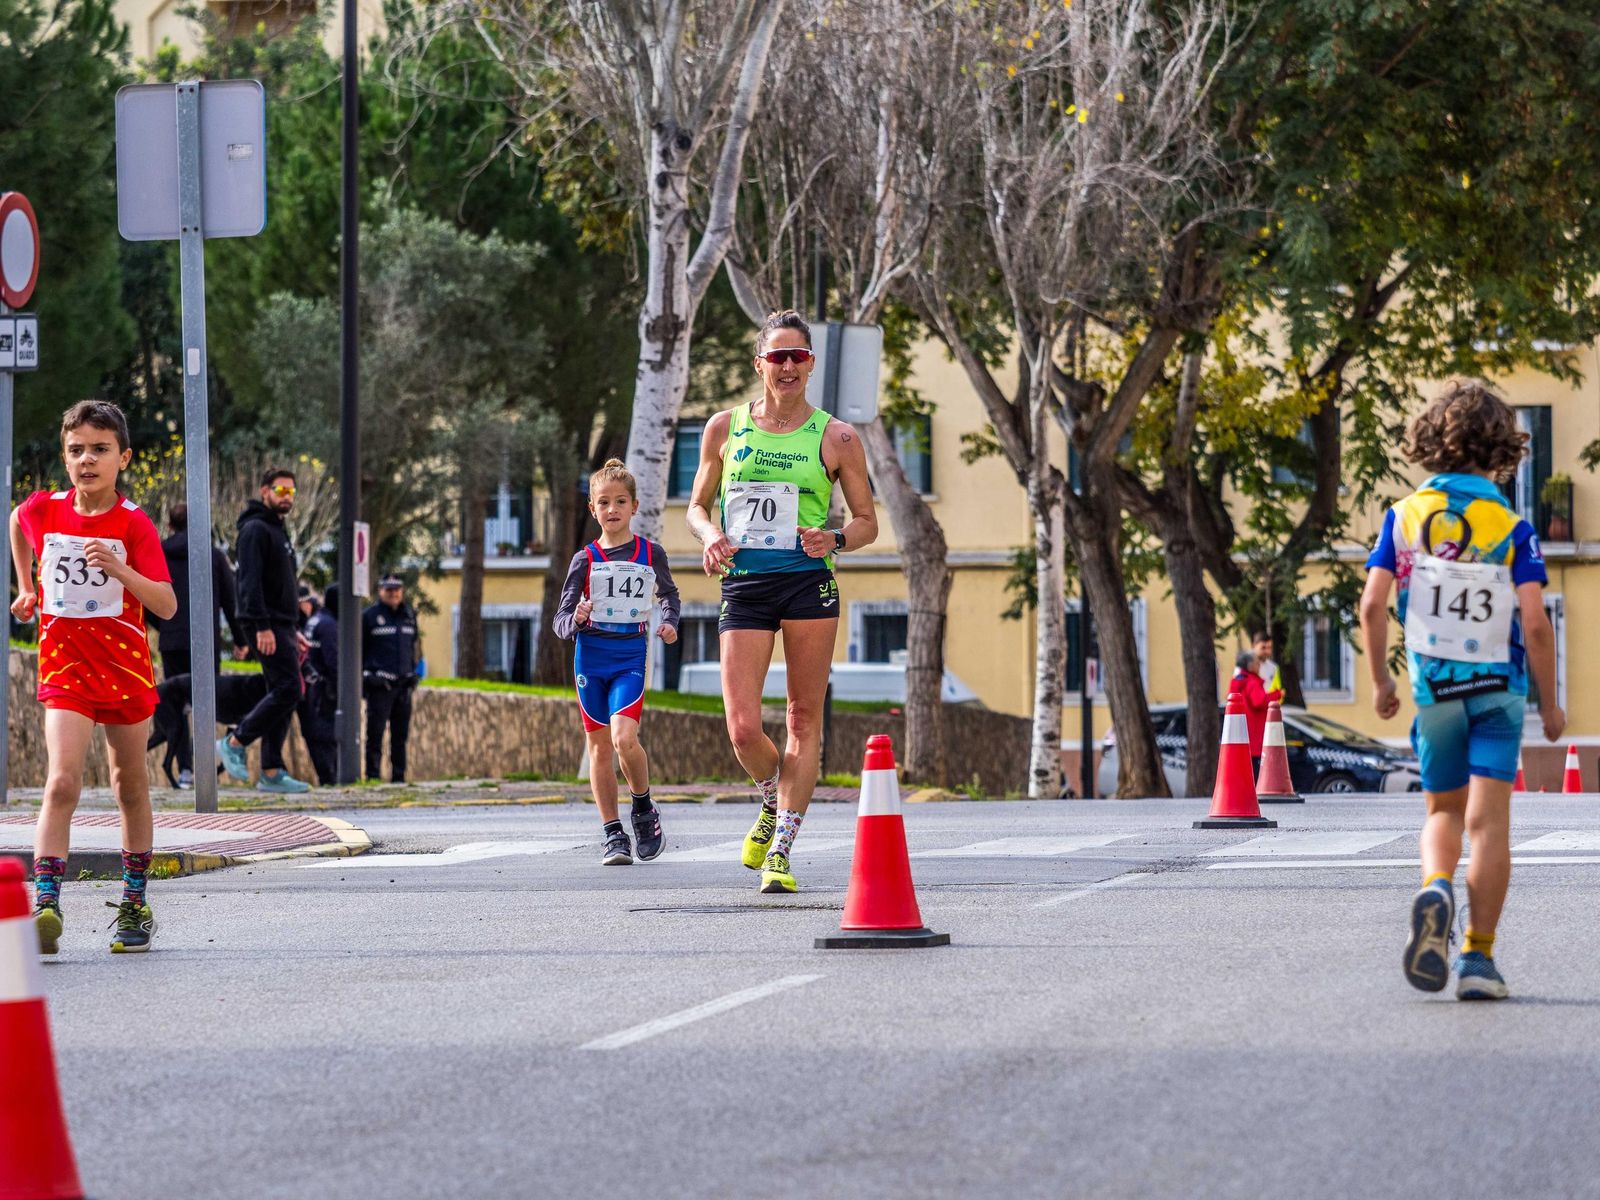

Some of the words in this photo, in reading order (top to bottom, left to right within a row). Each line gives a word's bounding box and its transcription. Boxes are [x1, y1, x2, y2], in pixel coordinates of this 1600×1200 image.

[754, 457, 793, 470] Unicaja
[756, 449, 808, 462] Fundación
[746, 498, 776, 522] 70
[55, 556, 109, 587] 533
[605, 576, 645, 598] 142
[1428, 585, 1493, 623] 143
